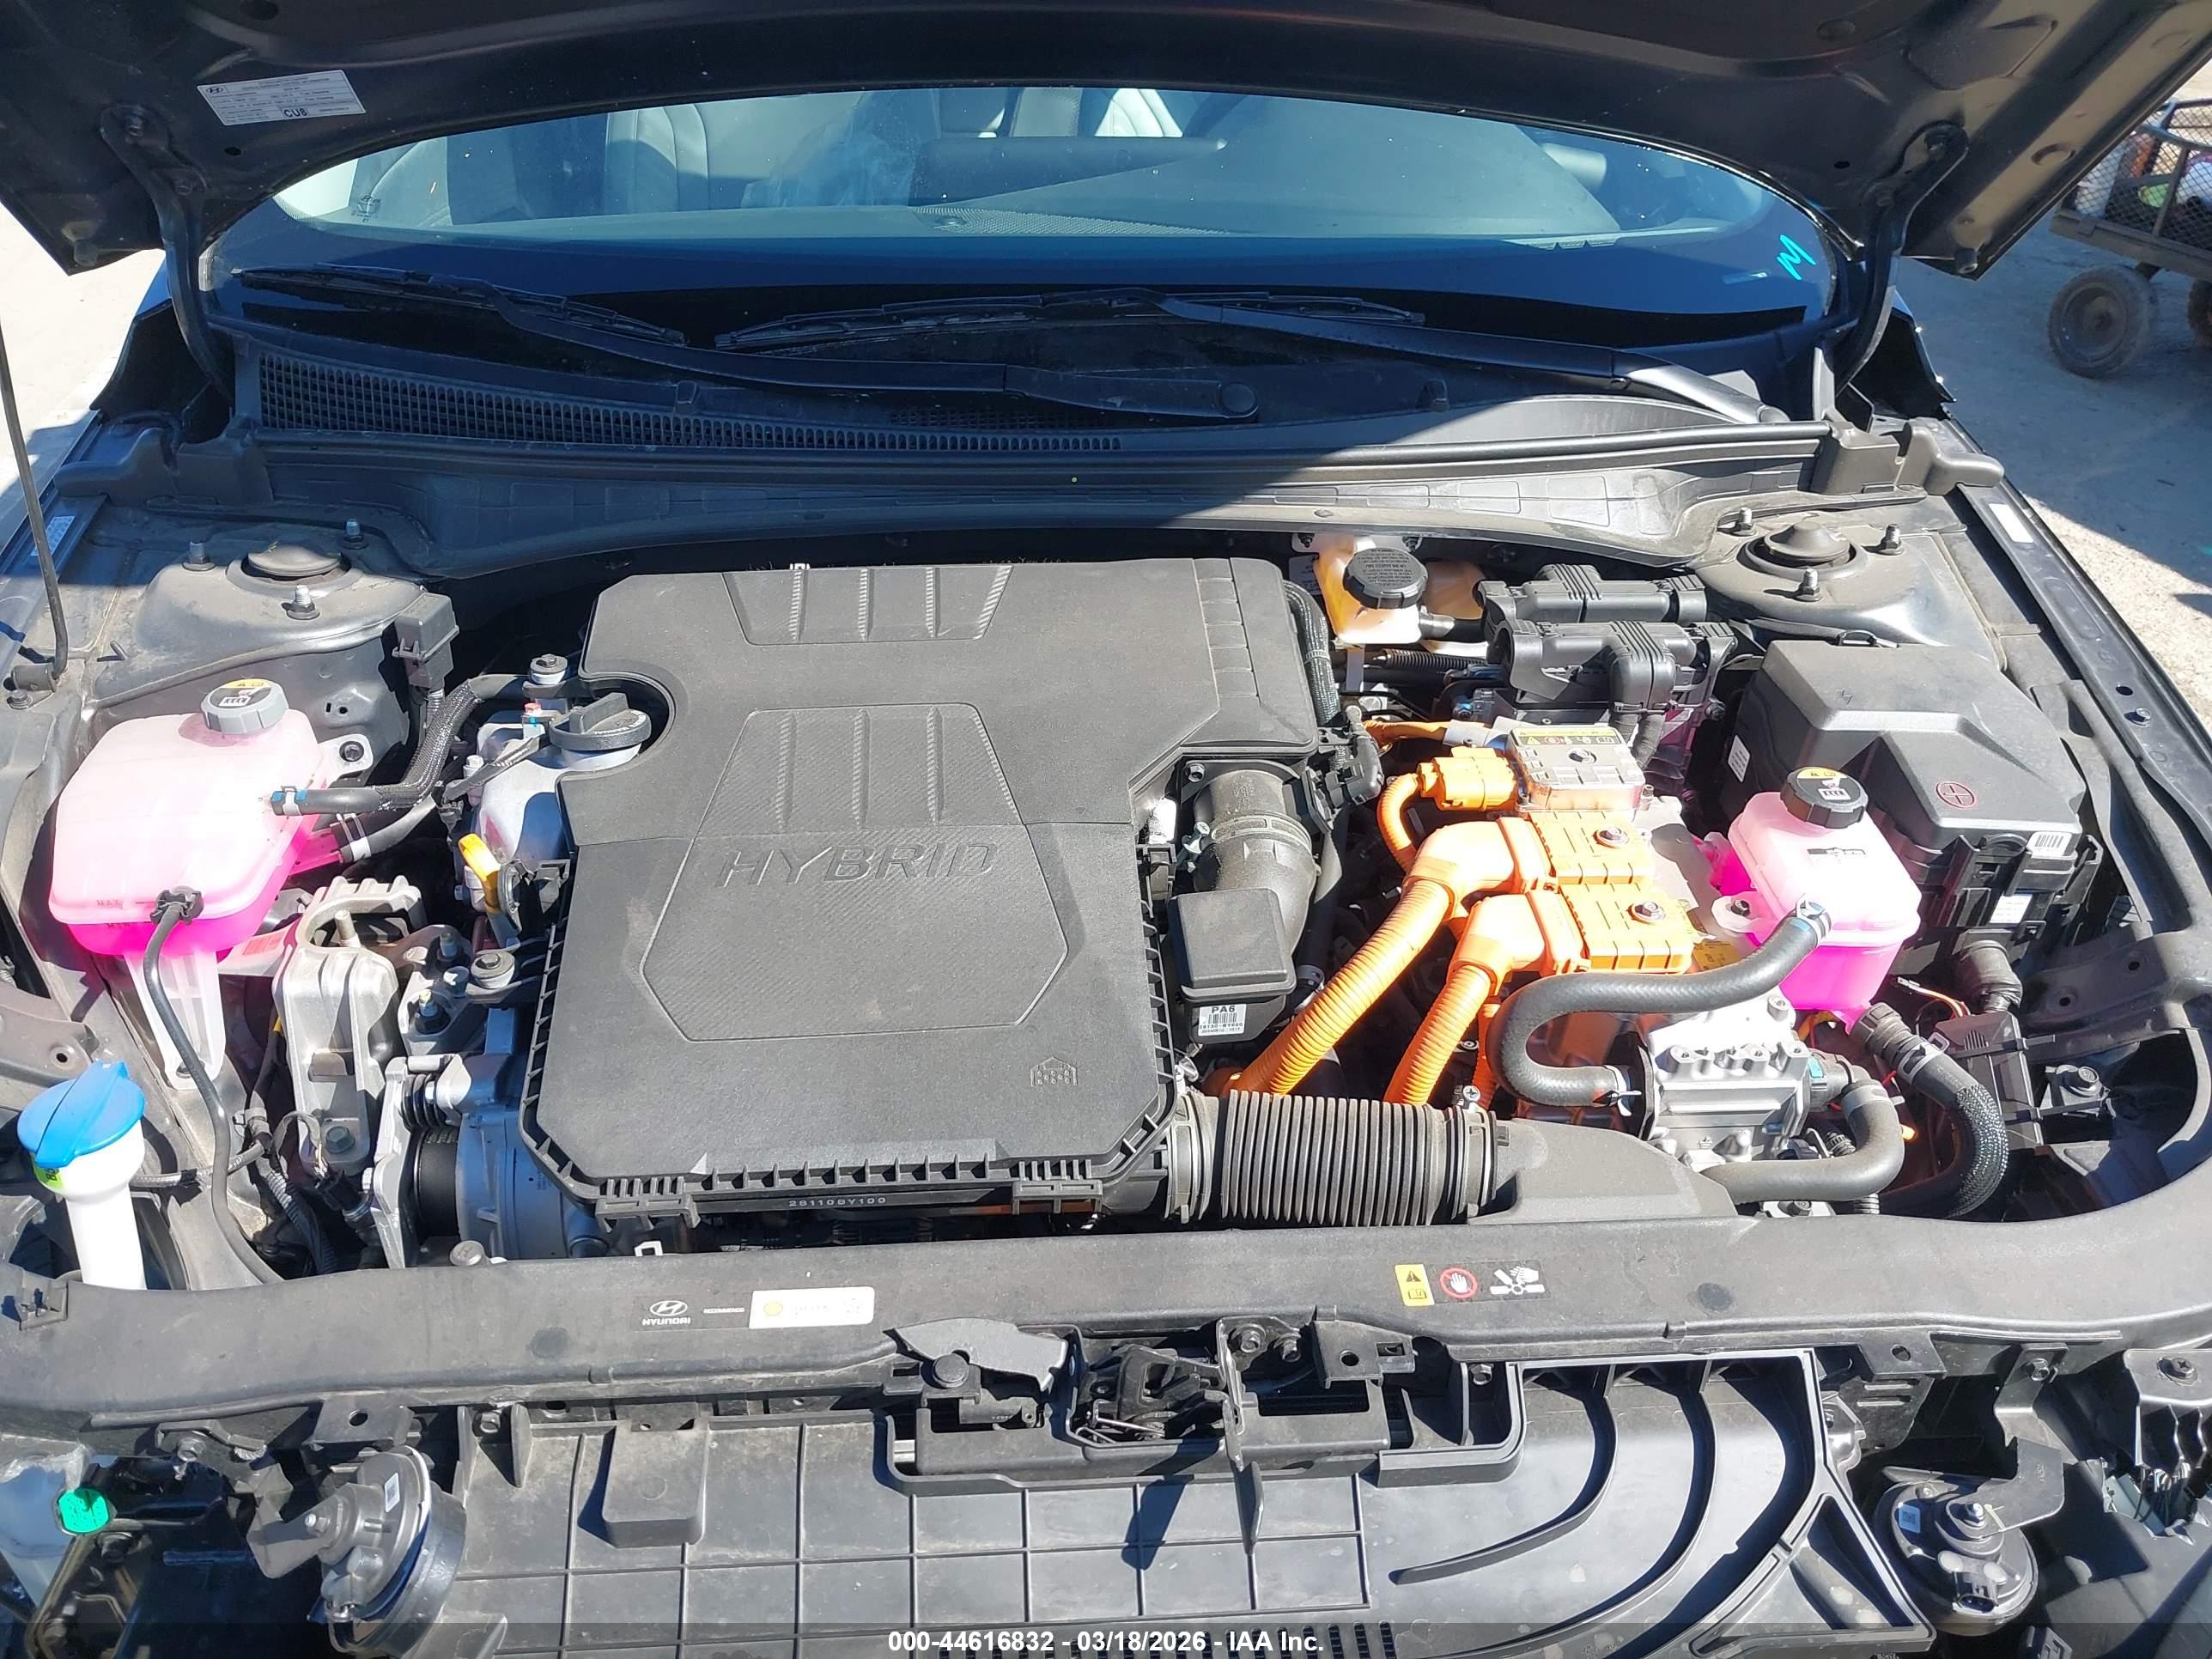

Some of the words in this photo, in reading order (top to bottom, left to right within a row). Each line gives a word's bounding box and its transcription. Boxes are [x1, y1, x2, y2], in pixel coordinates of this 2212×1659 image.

[283, 108, 307, 118] CU8
[714, 843, 1000, 888] HYBRID
[1211, 1005, 1236, 1014] PA6
[641, 1316, 691, 1327] HYUNDAI
